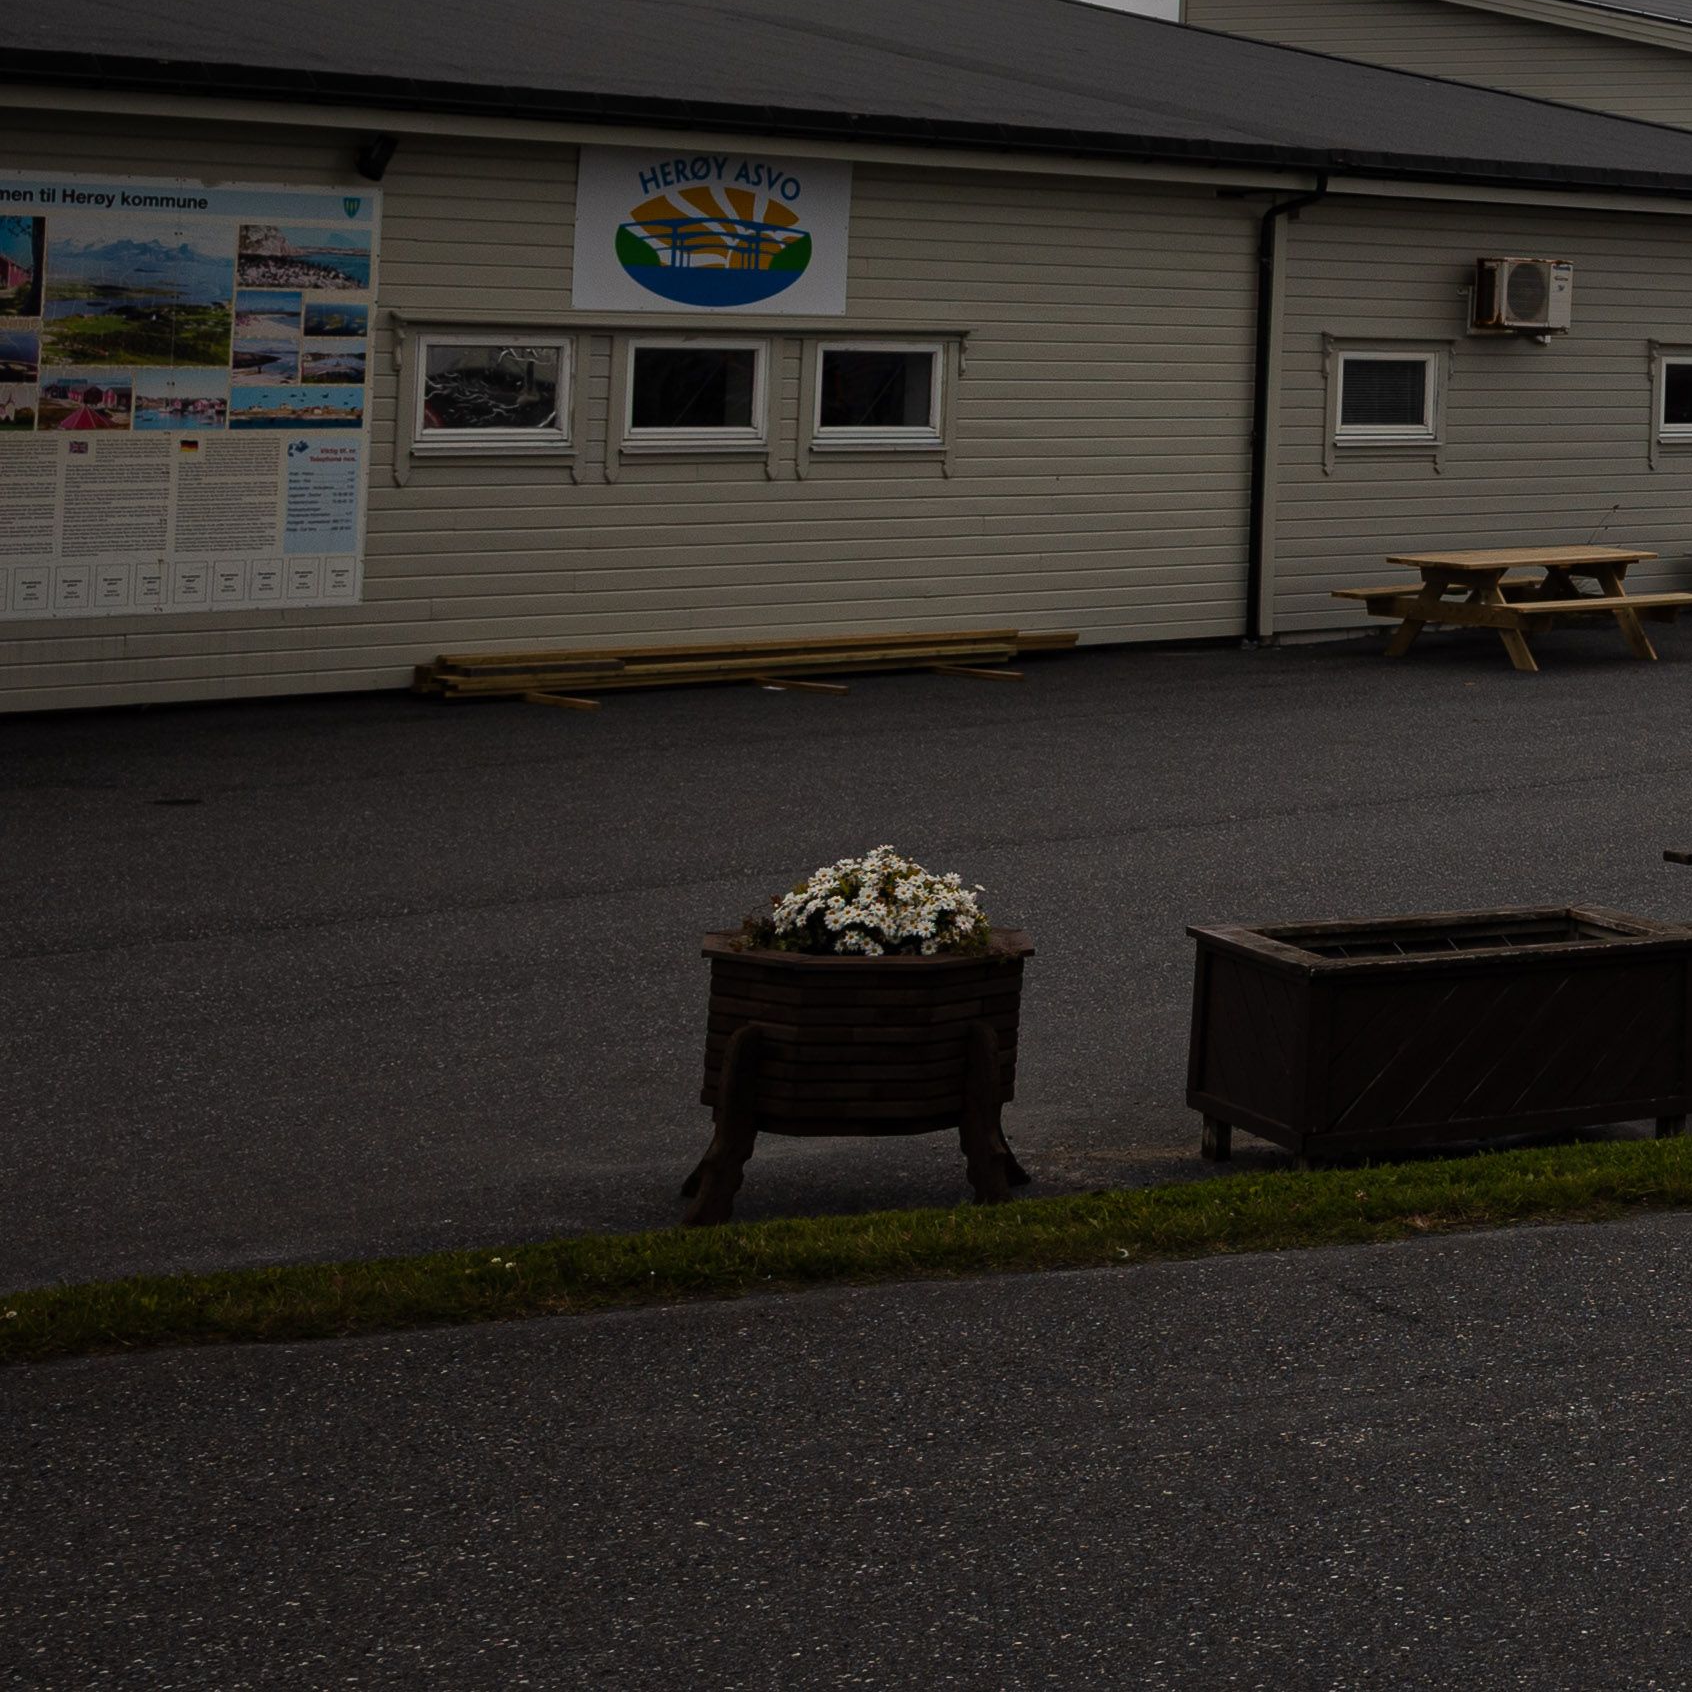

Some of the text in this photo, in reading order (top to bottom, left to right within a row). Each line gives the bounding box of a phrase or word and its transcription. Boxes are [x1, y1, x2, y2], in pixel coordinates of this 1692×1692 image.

[639, 156, 801, 201] HERØY ASVO
[39, 188, 56, 203] til
[62, 189, 116, 208] Herøy
[120, 192, 208, 209] kommune
